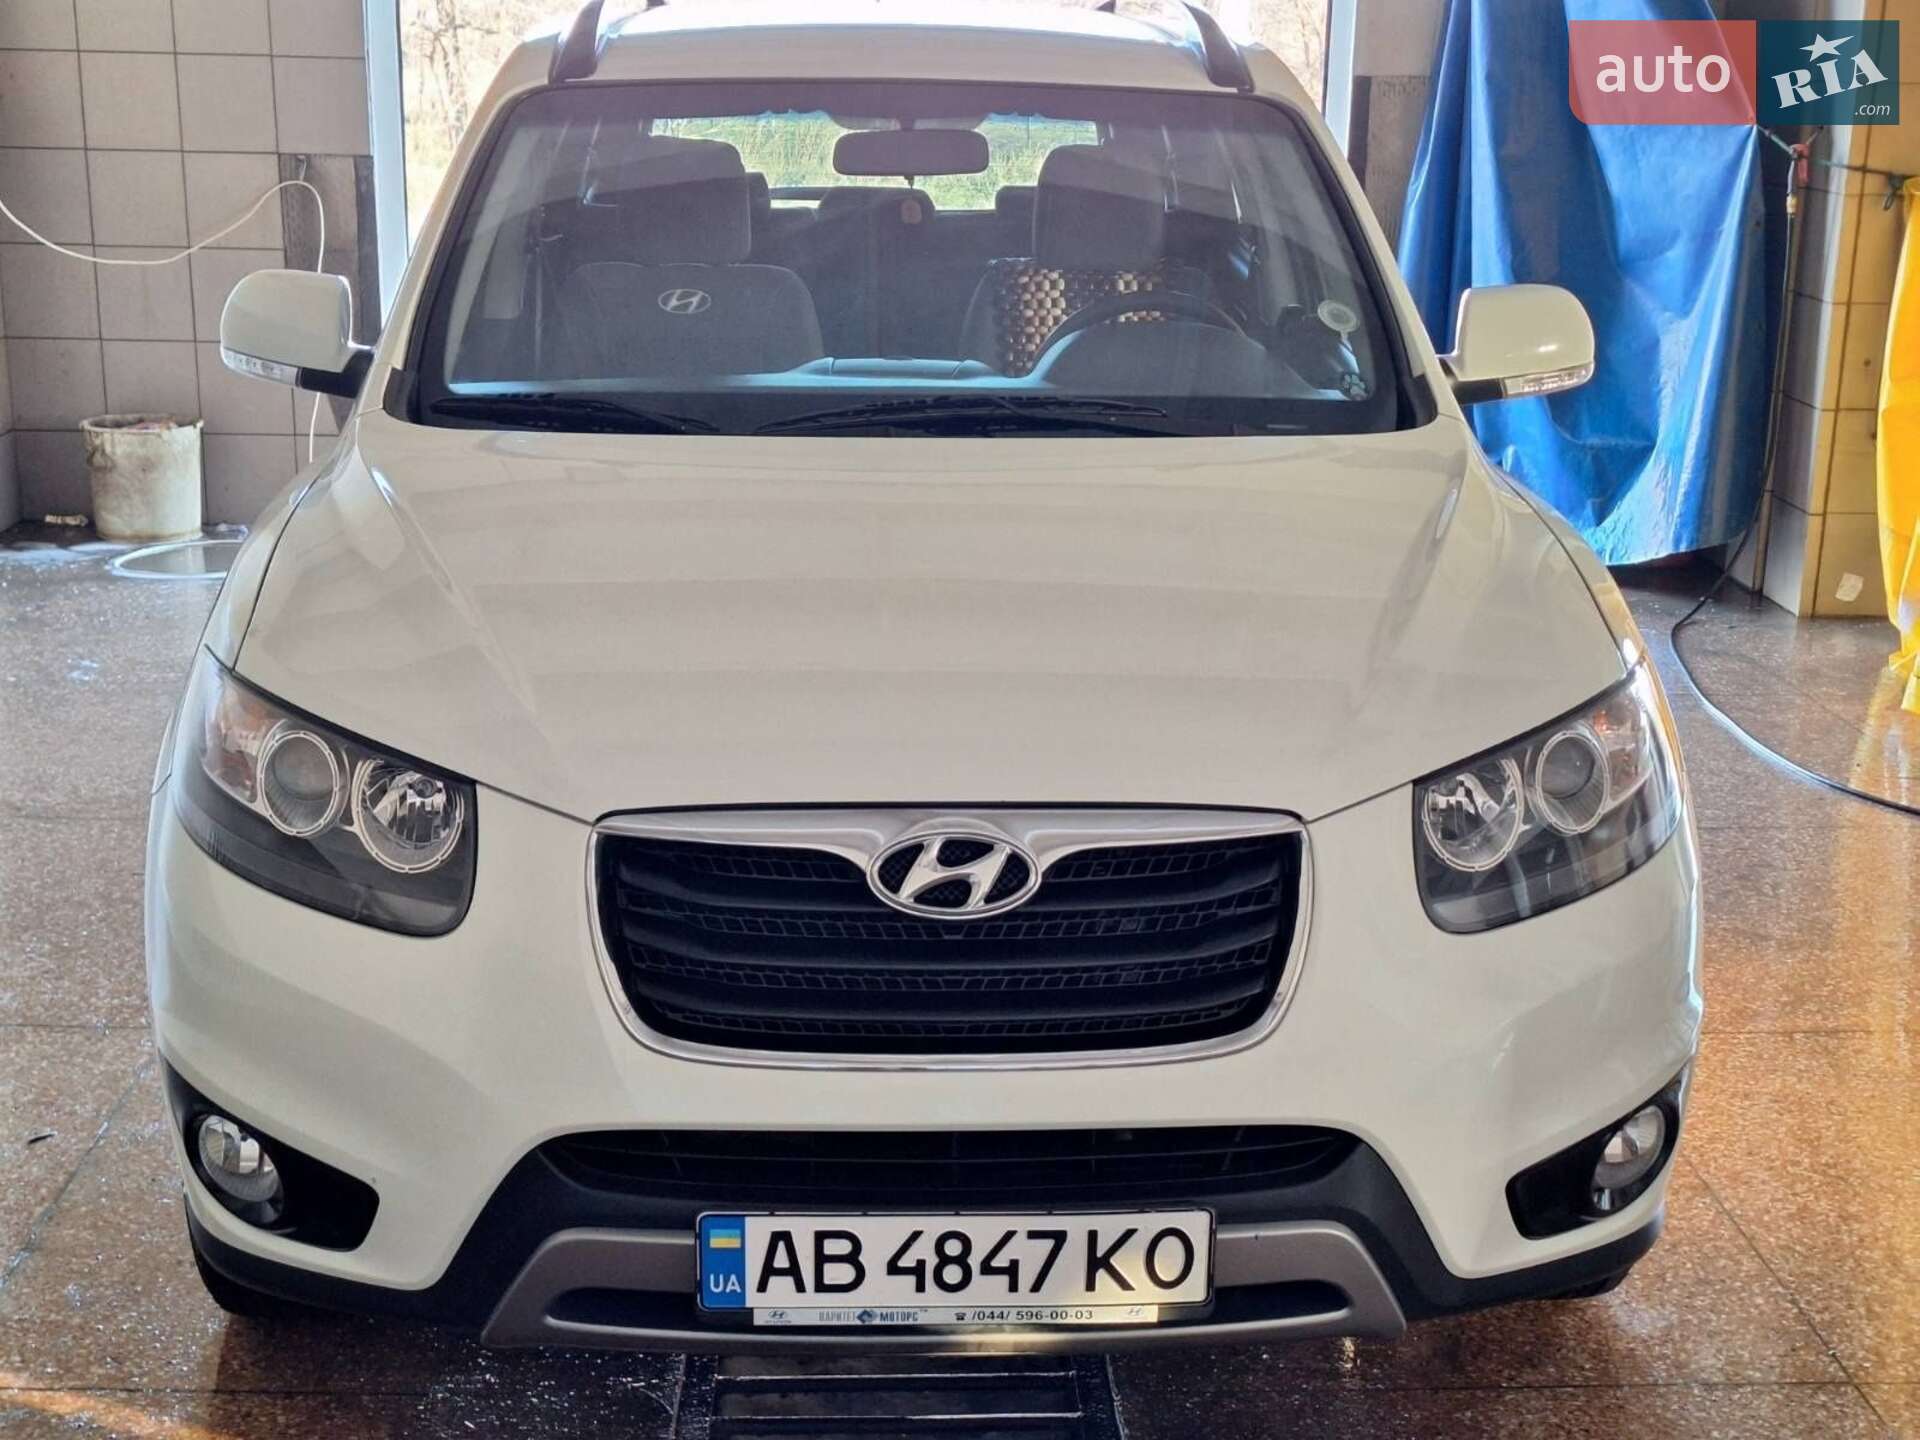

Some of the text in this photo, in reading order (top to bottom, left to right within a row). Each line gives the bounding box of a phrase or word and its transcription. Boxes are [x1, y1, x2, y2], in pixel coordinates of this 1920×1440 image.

[756, 1227, 1196, 1294] AB 4847 KO
[709, 1275, 741, 1295] UA
[879, 1311, 919, 1322] МОТОРС
[1015, 1309, 1094, 1321] 596-00-03
